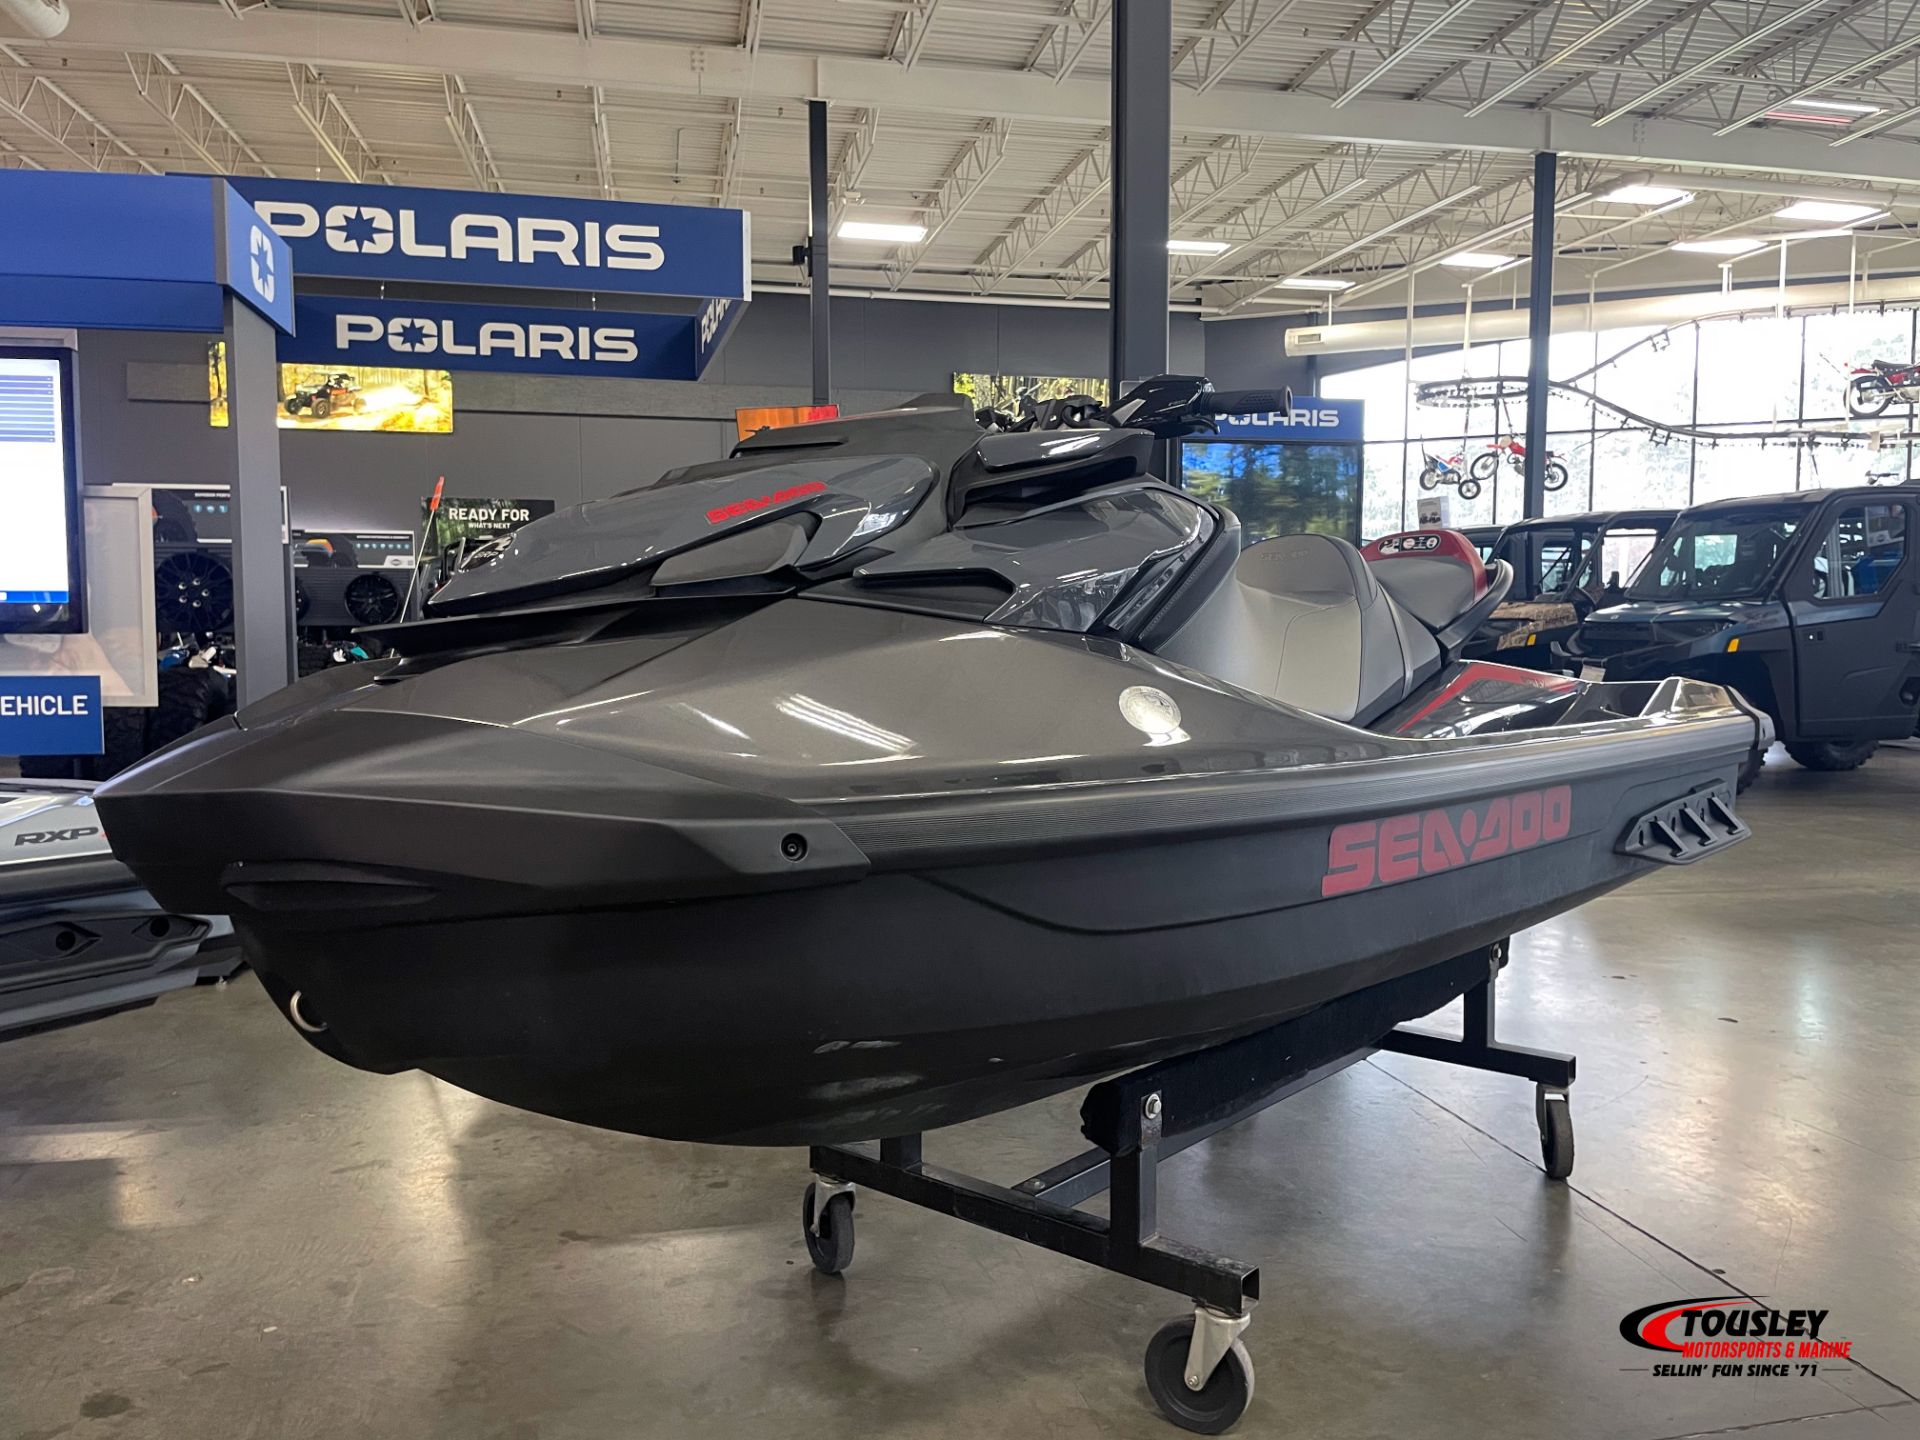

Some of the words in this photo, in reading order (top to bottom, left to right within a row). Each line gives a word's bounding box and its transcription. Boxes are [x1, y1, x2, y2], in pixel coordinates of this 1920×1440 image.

[254, 201, 665, 271] POLARIS
[336, 314, 639, 362] POLARIS
[448, 507, 498, 521] READY
[501, 508, 530, 521] FOR
[468, 521, 492, 529] WHAT'S
[0, 694, 89, 716] EHICLE
[14, 826, 99, 846] RXP
